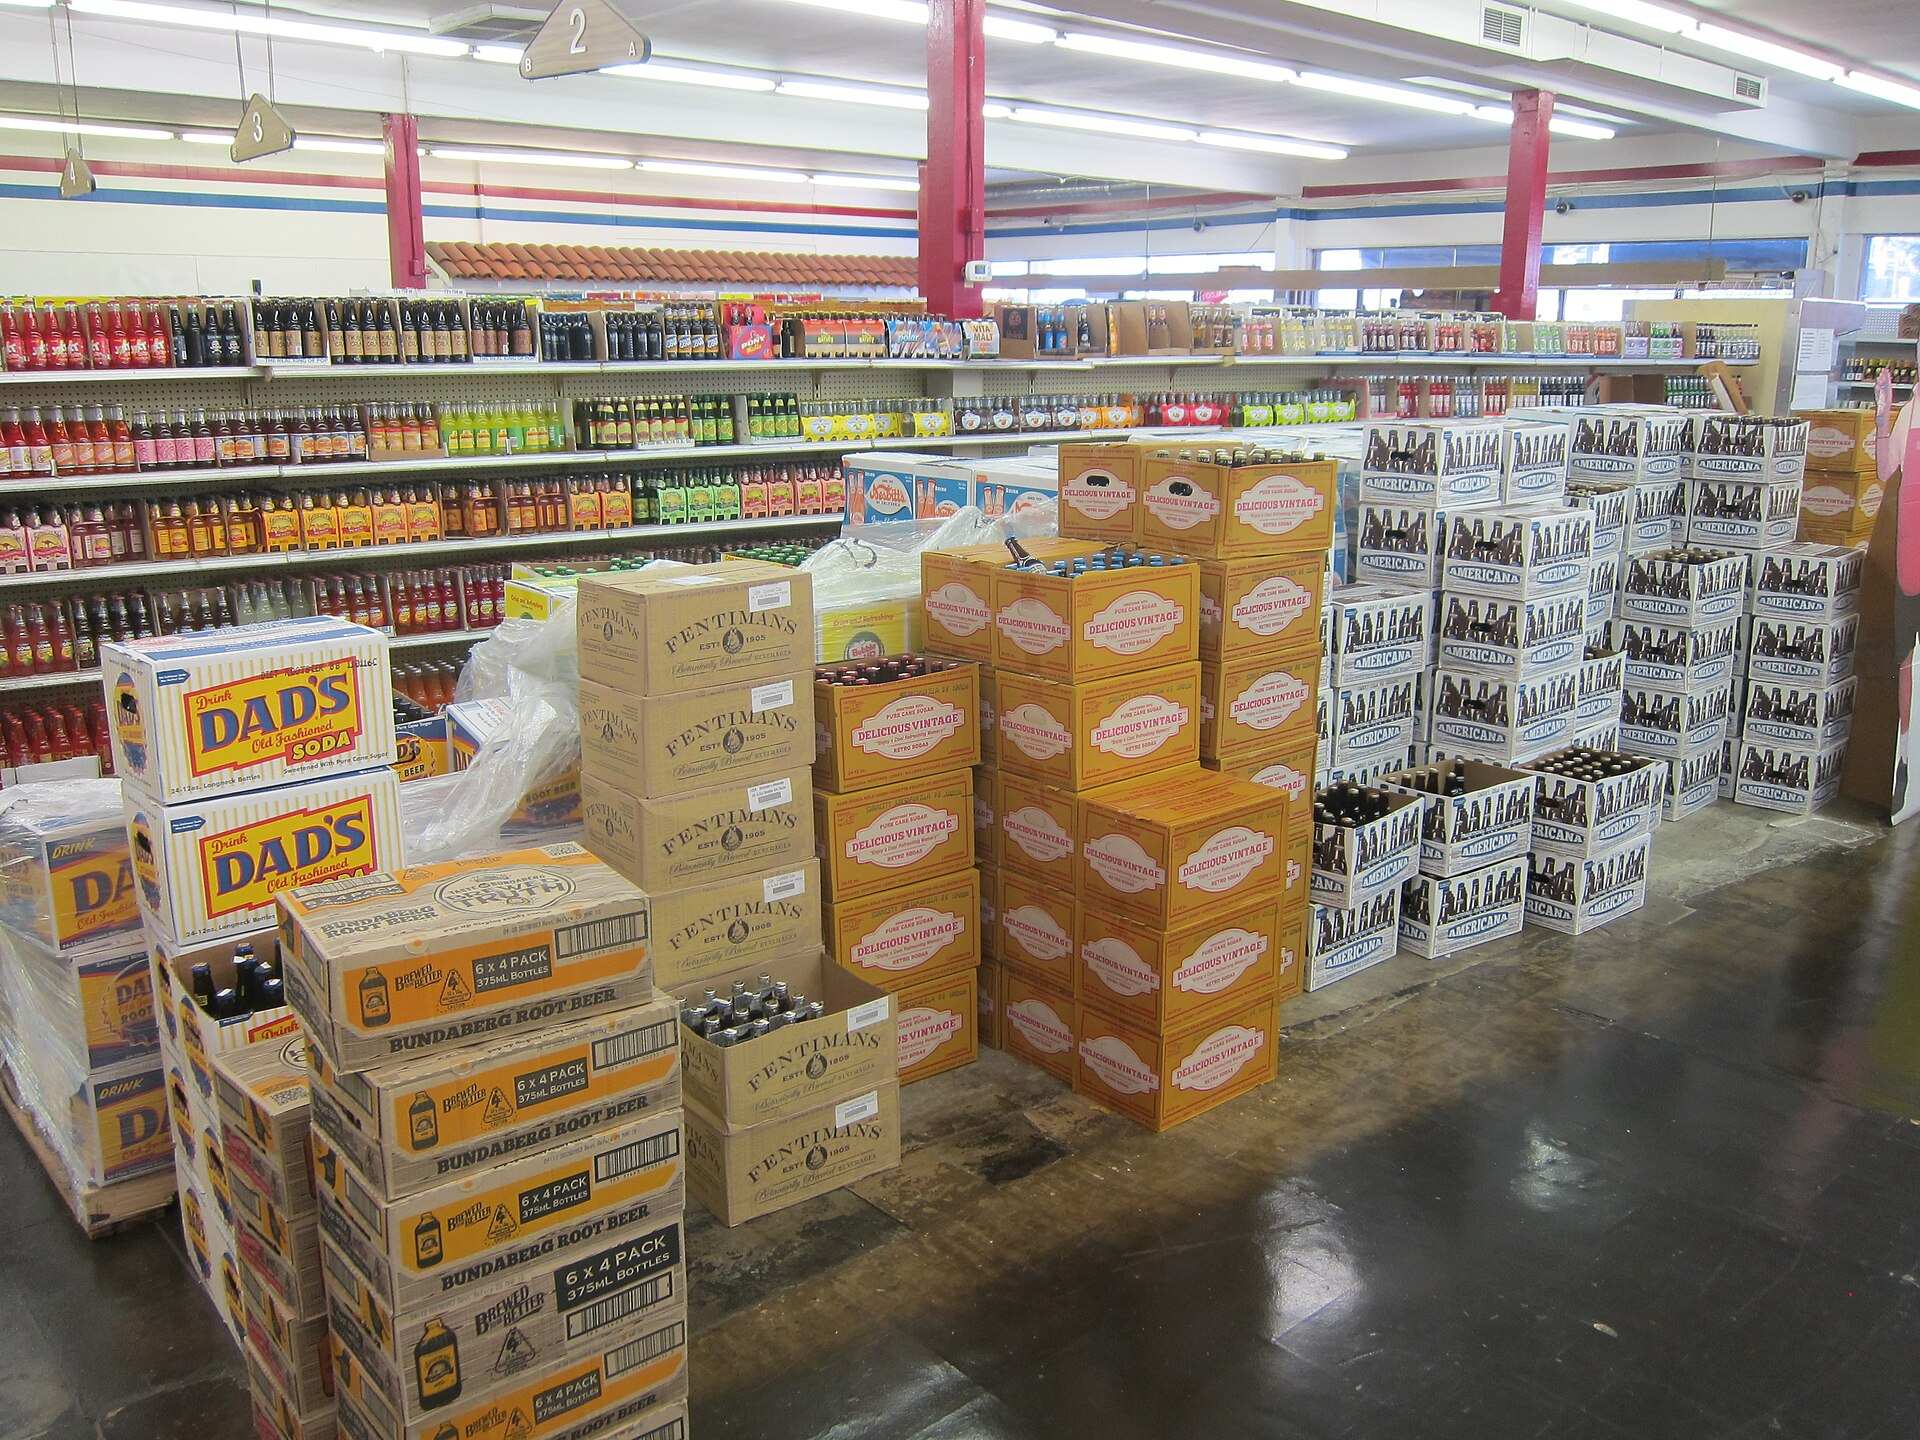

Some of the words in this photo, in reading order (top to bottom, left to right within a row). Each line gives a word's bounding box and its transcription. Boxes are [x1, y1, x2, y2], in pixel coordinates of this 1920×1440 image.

[569, 8, 587, 54] 2
[628, 41, 636, 56] A
[525, 58, 532, 71] B
[252, 112, 263, 144] 3
[70, 161, 76, 185] 4
[973, 325, 991, 333] VITA
[974, 333, 993, 341] MALT
[741, 335, 764, 350] PONY
[1573, 458, 1634, 472] AMERICANA
[1700, 459, 1762, 472] AMERICANA
[1366, 477, 1434, 493] AMERICANA
[1450, 476, 1490, 491] AMERICANA
[1519, 472, 1556, 488] AMERICANA
[1064, 489, 1098, 498] DELICIOUS
[1098, 490, 1131, 499] VINTAGE
[1146, 495, 1180, 506] DELICIOUS
[1180, 500, 1215, 511] VINTAGE
[1237, 500, 1279, 512] DELICIOUS
[1278, 498, 1318, 510] VINTAGE
[1694, 521, 1758, 536] AMERICANA
[1362, 555, 1425, 571] AMERICANA
[1450, 566, 1520, 584] AMERICANA
[1537, 565, 1580, 582] AMERICANA
[927, 600, 959, 614] DELICIOUS
[959, 605, 989, 618] VINTAGE
[1237, 602, 1272, 617] DELICIOUS
[1272, 596, 1308, 610] VINTAGE
[1626, 600, 1688, 615] AMERICANA
[1759, 596, 1824, 612] AMERICANA
[580, 607, 639, 641] FENTIMANS
[665, 610, 797, 655] FENTIMANS
[998, 616, 1034, 630] DELICIOUS
[1033, 620, 1067, 636] VINTAGE
[1089, 619, 1136, 635] DELICIOUS
[1136, 611, 1179, 625] VINTAGE
[1354, 650, 1412, 669] AMERICANA
[1444, 646, 1515, 665] AMERICANA
[1531, 642, 1574, 663] AMERICANA
[1753, 660, 1820, 677] AMERICANA
[196, 690, 232, 710] Drink
[1234, 698, 1271, 713] DELICIOUS
[1271, 689, 1306, 704] VINTAGE
[197, 673, 350, 754] DAD'S
[252, 732, 274, 754] Old
[275, 719, 333, 747] Fashioned
[665, 709, 797, 757] FENTIMANS
[858, 723, 911, 740] DELICIOUS
[912, 713, 959, 730] VINTAGE
[1095, 721, 1141, 741] DELICIOUS
[1141, 712, 1184, 730] VINTAGE
[1350, 727, 1401, 748] AMERICANA
[1438, 723, 1505, 743] AMERICANA
[1523, 719, 1567, 741] AMERICANA
[1750, 724, 1814, 741] AMERICANA
[292, 730, 352, 760] SODA
[283, 762, 319, 775] Sweetened
[320, 758, 334, 771] With
[336, 756, 351, 767] Pure
[352, 754, 369, 765] Cane
[369, 751, 389, 764] Sugar
[404, 764, 425, 777] BEER
[203, 776, 236, 789] Longneck
[237, 772, 261, 784] Bottles
[1741, 785, 1806, 802] AMERICANA
[661, 809, 798, 856] FENTIMANS
[852, 829, 904, 853] DELICIOUS
[905, 819, 952, 839] VINTAGE
[1005, 820, 1038, 838] DELICIOUS
[1038, 830, 1070, 848] VINTAGE
[1600, 815, 1641, 840] AMERICANA
[52, 837, 96, 859] DRINK
[211, 832, 248, 855] Drink
[213, 810, 366, 897] DAD'S
[1462, 833, 1518, 857] AMERICANA
[1086, 847, 1122, 866] DELICIOUS
[1122, 859, 1160, 879] VINTAGE
[1183, 857, 1227, 876] DELICIOUS
[1227, 841, 1268, 862] VINTAGE
[266, 876, 289, 894] Old
[290, 858, 349, 887] Fashioned
[1362, 857, 1410, 888] AMERICANA
[1588, 890, 1634, 916] AMERICANA
[218, 918, 251, 931] Longneck
[253, 914, 276, 924] Bottles
[320, 906, 434, 933] BUNDABERG
[326, 921, 382, 939] ROOT
[386, 910, 439, 928] BEER
[669, 901, 803, 950] FENTIMANS
[1449, 913, 1509, 938] AMERICANA
[857, 935, 910, 957] DELICIOUS
[911, 921, 959, 941] VINTAGE
[475, 963, 484, 974] 6
[499, 960, 508, 970] 4
[510, 950, 547, 968] PACK
[1177, 959, 1222, 980] DELICIOUS
[1222, 941, 1262, 963] VINTAGE
[1325, 937, 1384, 969] AMERICANA
[395, 963, 433, 991] BREWED
[510, 966, 549, 980] BOTTLES
[261, 1020, 299, 1041] Drink
[390, 1013, 512, 1054] BUNDABERG
[516, 1000, 567, 1024] ROOT
[571, 988, 616, 1008] BEER
[911, 1019, 956, 1039] VINTAGE
[748, 1032, 881, 1093] FENTIMANS
[1176, 1057, 1220, 1079] DELICIOUS
[1220, 1037, 1260, 1060] VINTAGE
[100, 1077, 144, 1100] DRINK
[517, 1080, 526, 1091] 6
[540, 1075, 548, 1085] 4
[550, 1063, 585, 1082] PACK
[550, 1077, 586, 1094] BOTTLES
[443, 1083, 477, 1113] BREWED
[437, 1125, 551, 1175] BUNDABERG
[554, 1110, 603, 1136] ROOT
[606, 1094, 649, 1117] BEER
[748, 1124, 882, 1184] FENTIMANS
[521, 1195, 530, 1207] 6
[543, 1189, 551, 1199] 4
[553, 1177, 588, 1195] PACK
[552, 1190, 588, 1207] BOTTLES
[447, 1202, 482, 1232] BREWED
[441, 1238, 555, 1292] BUNDABERG
[557, 1221, 604, 1250] ROOT
[606, 1204, 651, 1229] BEER
[566, 1270, 578, 1286] 6
[599, 1257, 611, 1272] 4
[614, 1235, 666, 1267] PACK
[616, 1252, 670, 1281] BOTTLES
[475, 1284, 530, 1336] BREWED
[503, 1292, 545, 1327] BETTER
[556, 1390, 564, 1401] 4
[566, 1375, 598, 1396] PACK
[569, 1413, 615, 1440] ROOT
[618, 1394, 657, 1420] BEER
